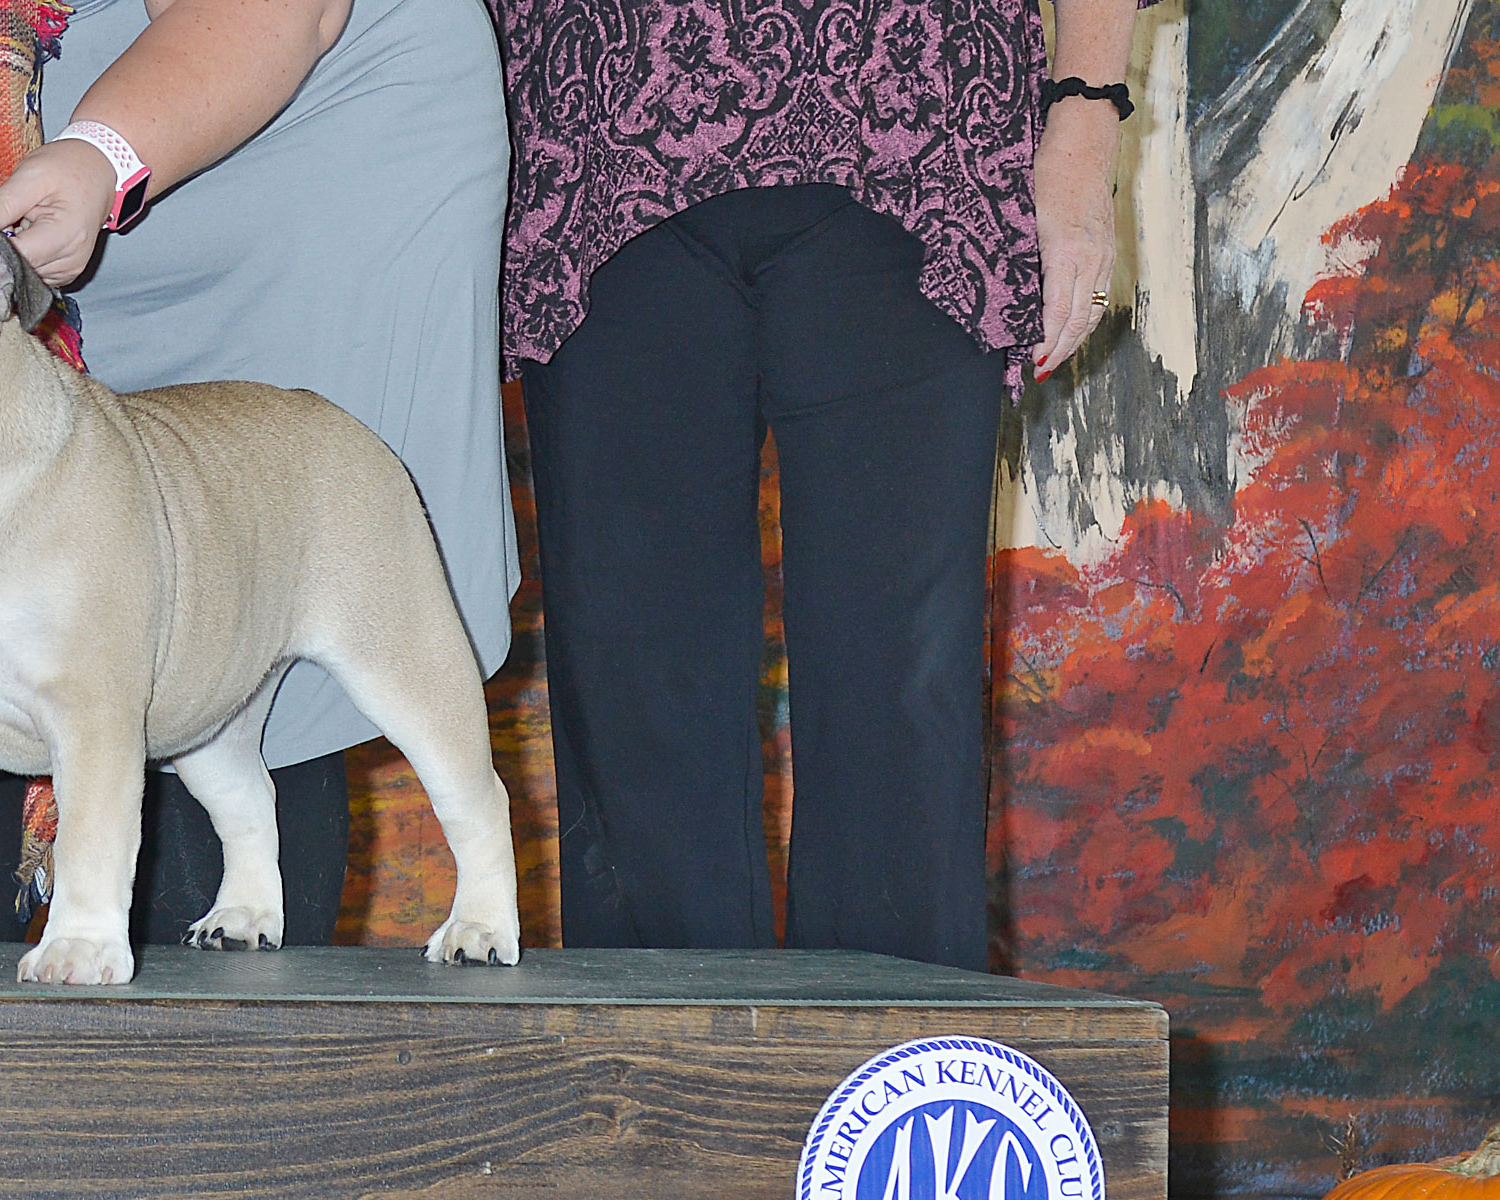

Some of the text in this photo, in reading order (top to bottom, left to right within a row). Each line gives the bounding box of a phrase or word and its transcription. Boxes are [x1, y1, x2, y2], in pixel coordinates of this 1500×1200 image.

[820, 1059, 1083, 1200] MERICAN KENNEL CLU
